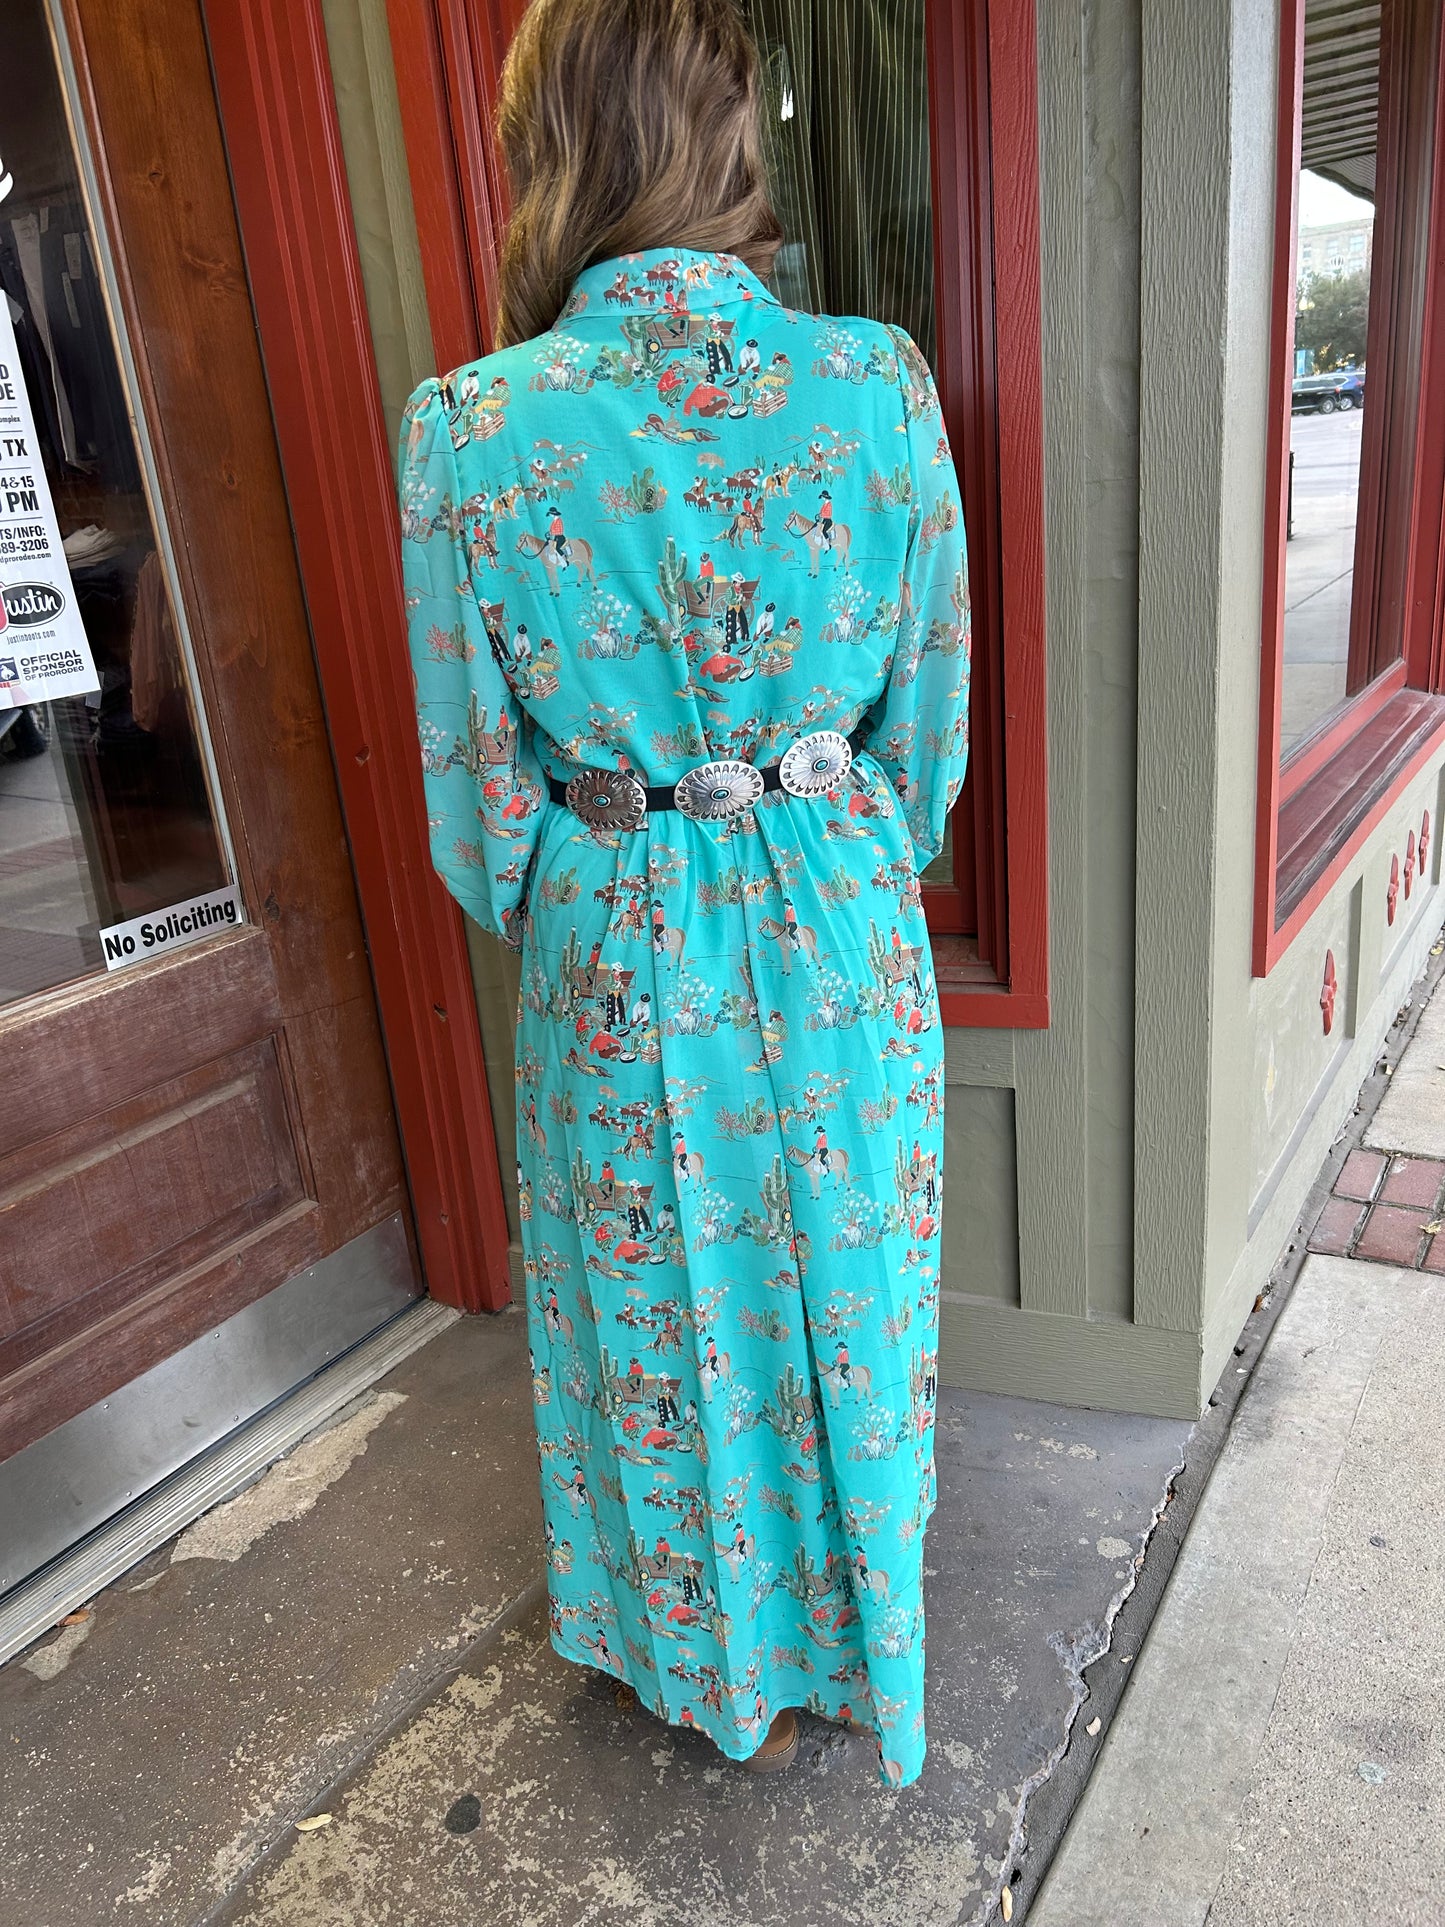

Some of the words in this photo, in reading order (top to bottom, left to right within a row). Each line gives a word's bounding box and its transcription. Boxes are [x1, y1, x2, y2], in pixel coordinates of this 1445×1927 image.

[3, 439, 28, 456] TX
[0, 475, 34, 489] 4&15
[6, 490, 39, 512] PM
[0, 525, 46, 540] TS/INFO:
[0, 538, 49, 554] 89-3206
[20, 649, 81, 666] OFFICIAL
[23, 658, 83, 675] SPONSOR
[39, 665, 85, 678] PRORODEO
[104, 935, 135, 960] No
[140, 900, 237, 948] Soliciting
